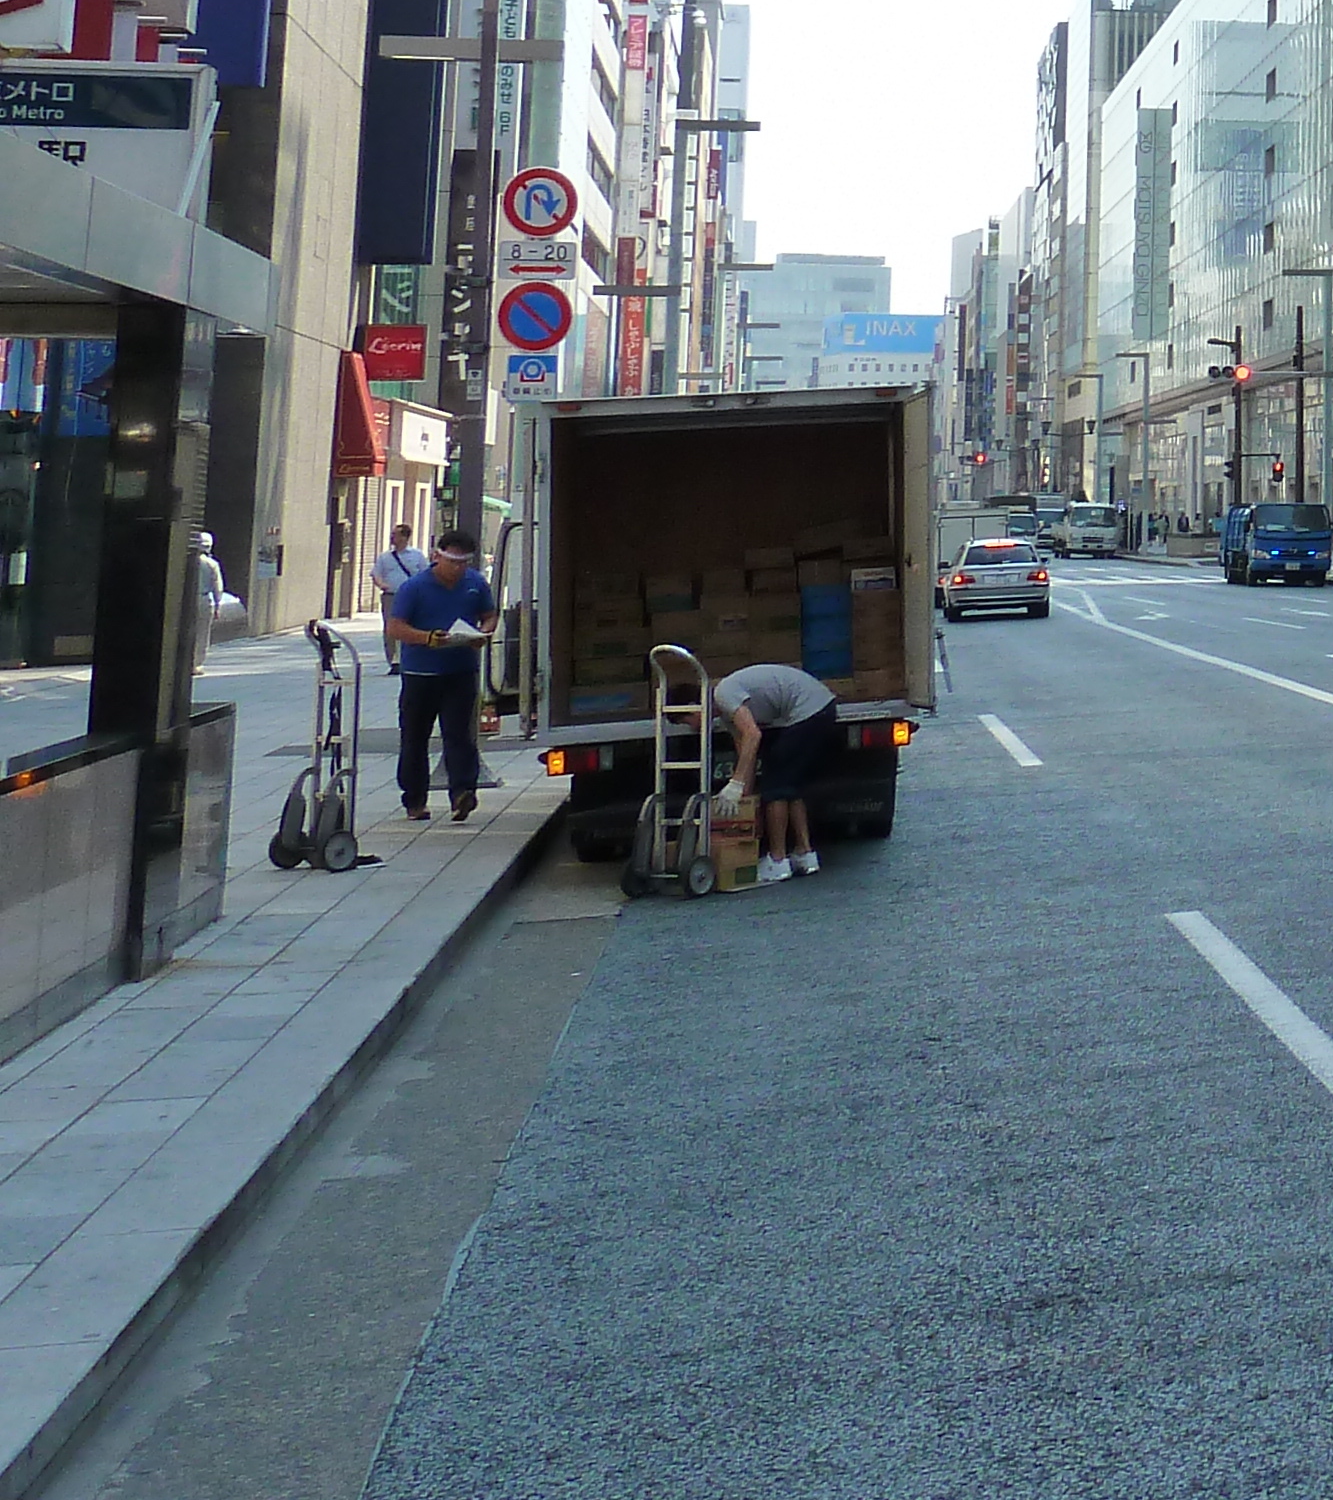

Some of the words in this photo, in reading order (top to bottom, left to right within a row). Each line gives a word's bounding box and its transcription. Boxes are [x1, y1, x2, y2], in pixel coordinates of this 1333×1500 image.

[0, 79, 74, 102] メトロ
[865, 320, 917, 336] INAX
